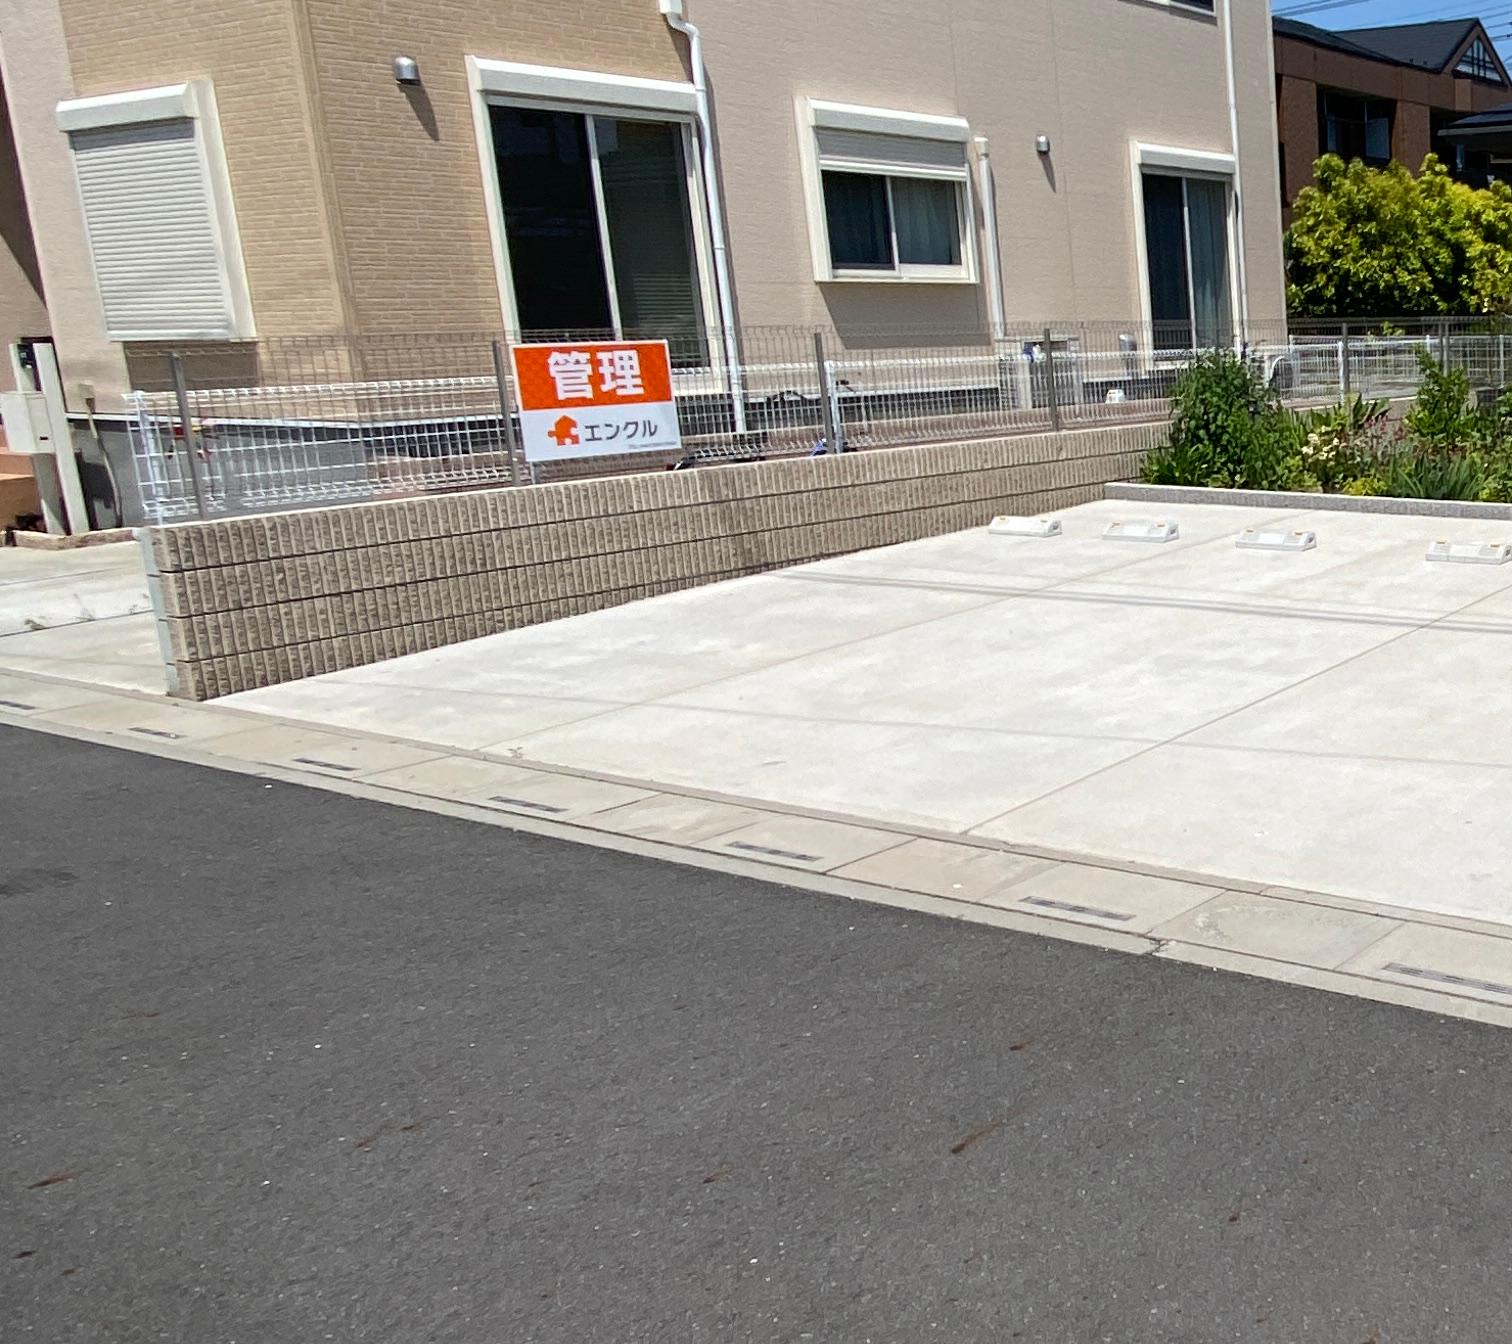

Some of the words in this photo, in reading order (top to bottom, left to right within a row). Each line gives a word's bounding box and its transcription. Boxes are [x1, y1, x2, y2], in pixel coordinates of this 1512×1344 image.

[547, 349, 645, 401] 管理
[584, 419, 658, 442] エンクル
